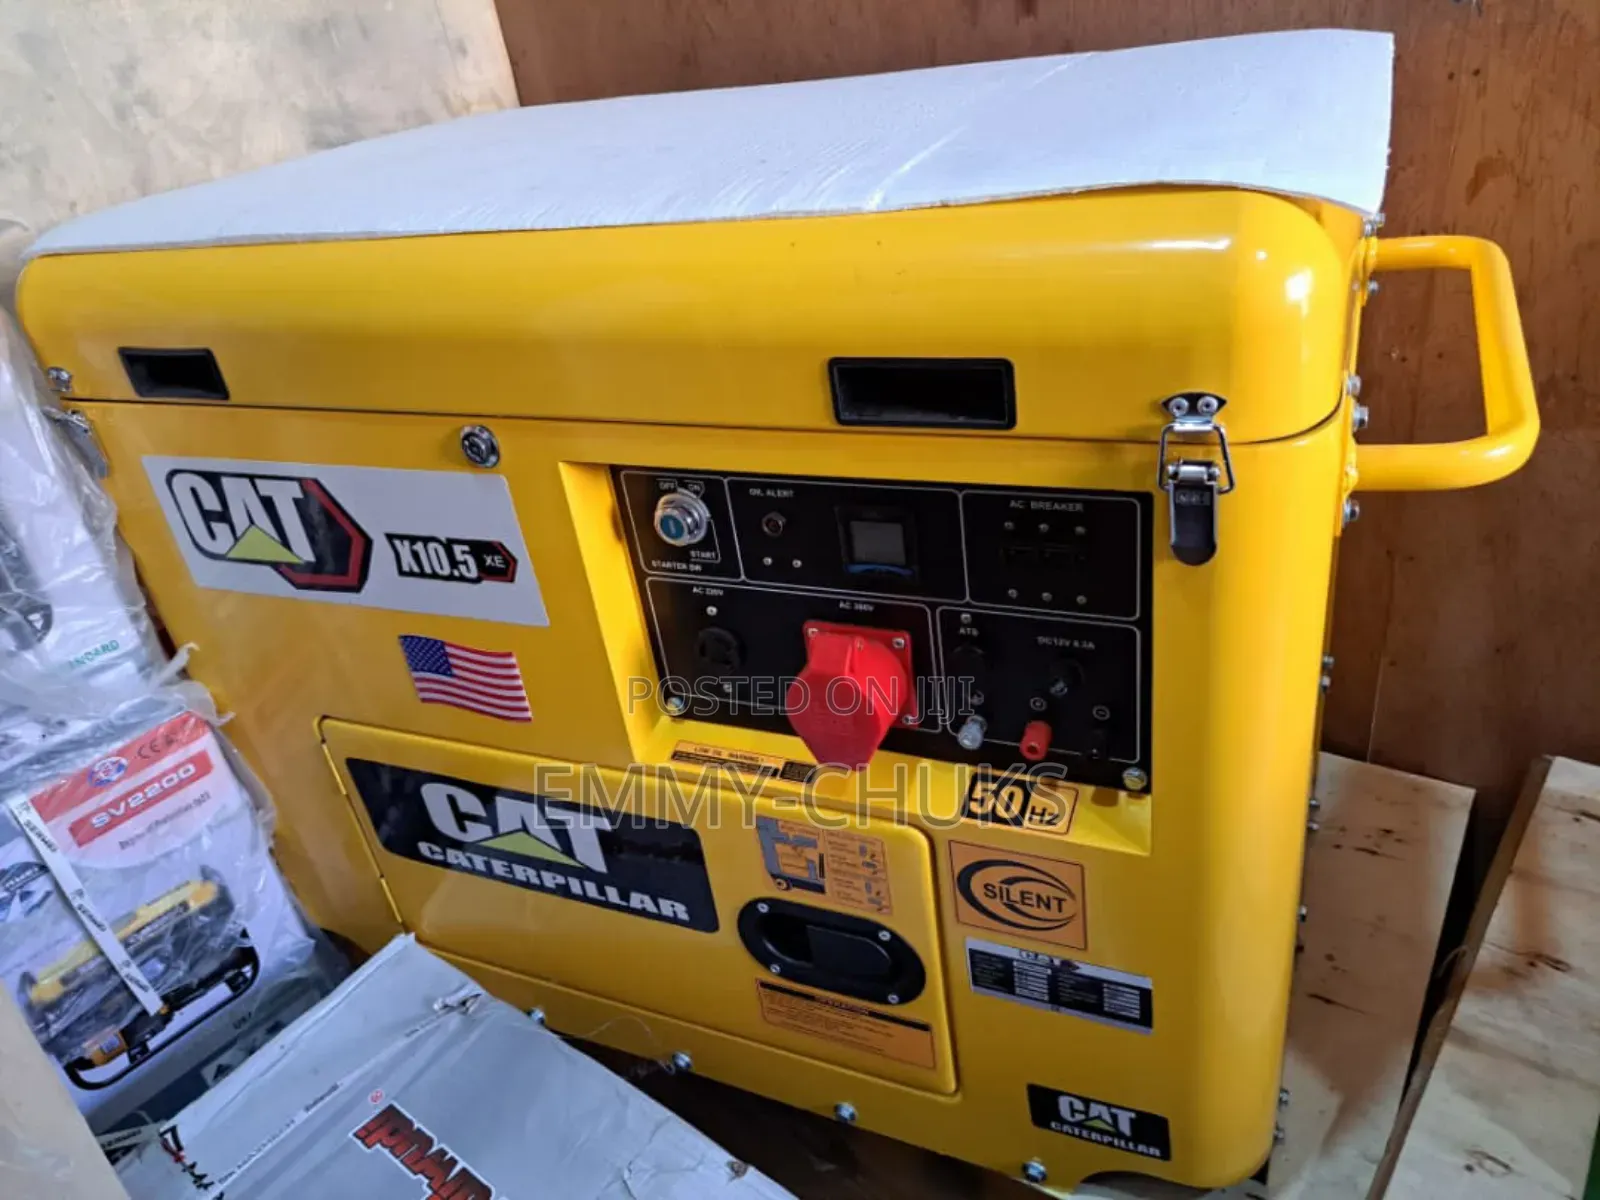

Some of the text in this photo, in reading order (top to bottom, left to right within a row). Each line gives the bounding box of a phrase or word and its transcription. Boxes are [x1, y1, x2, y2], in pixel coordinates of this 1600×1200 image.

[659, 482, 675, 491] OFF
[766, 489, 794, 498] ALERT
[1009, 500, 1084, 512] AC BREAKER
[170, 471, 316, 563] CAT
[393, 539, 505, 579] X10.5 XE
[89, 762, 197, 829] SV2200
[968, 779, 1060, 827] 50 Hz
[420, 782, 612, 874] CAT
[417, 841, 690, 922] CATERPILLAR
[983, 882, 1067, 914] SILENT
[1058, 1094, 1137, 1137] CAT
[1050, 1121, 1161, 1157] CATERPILLAR
